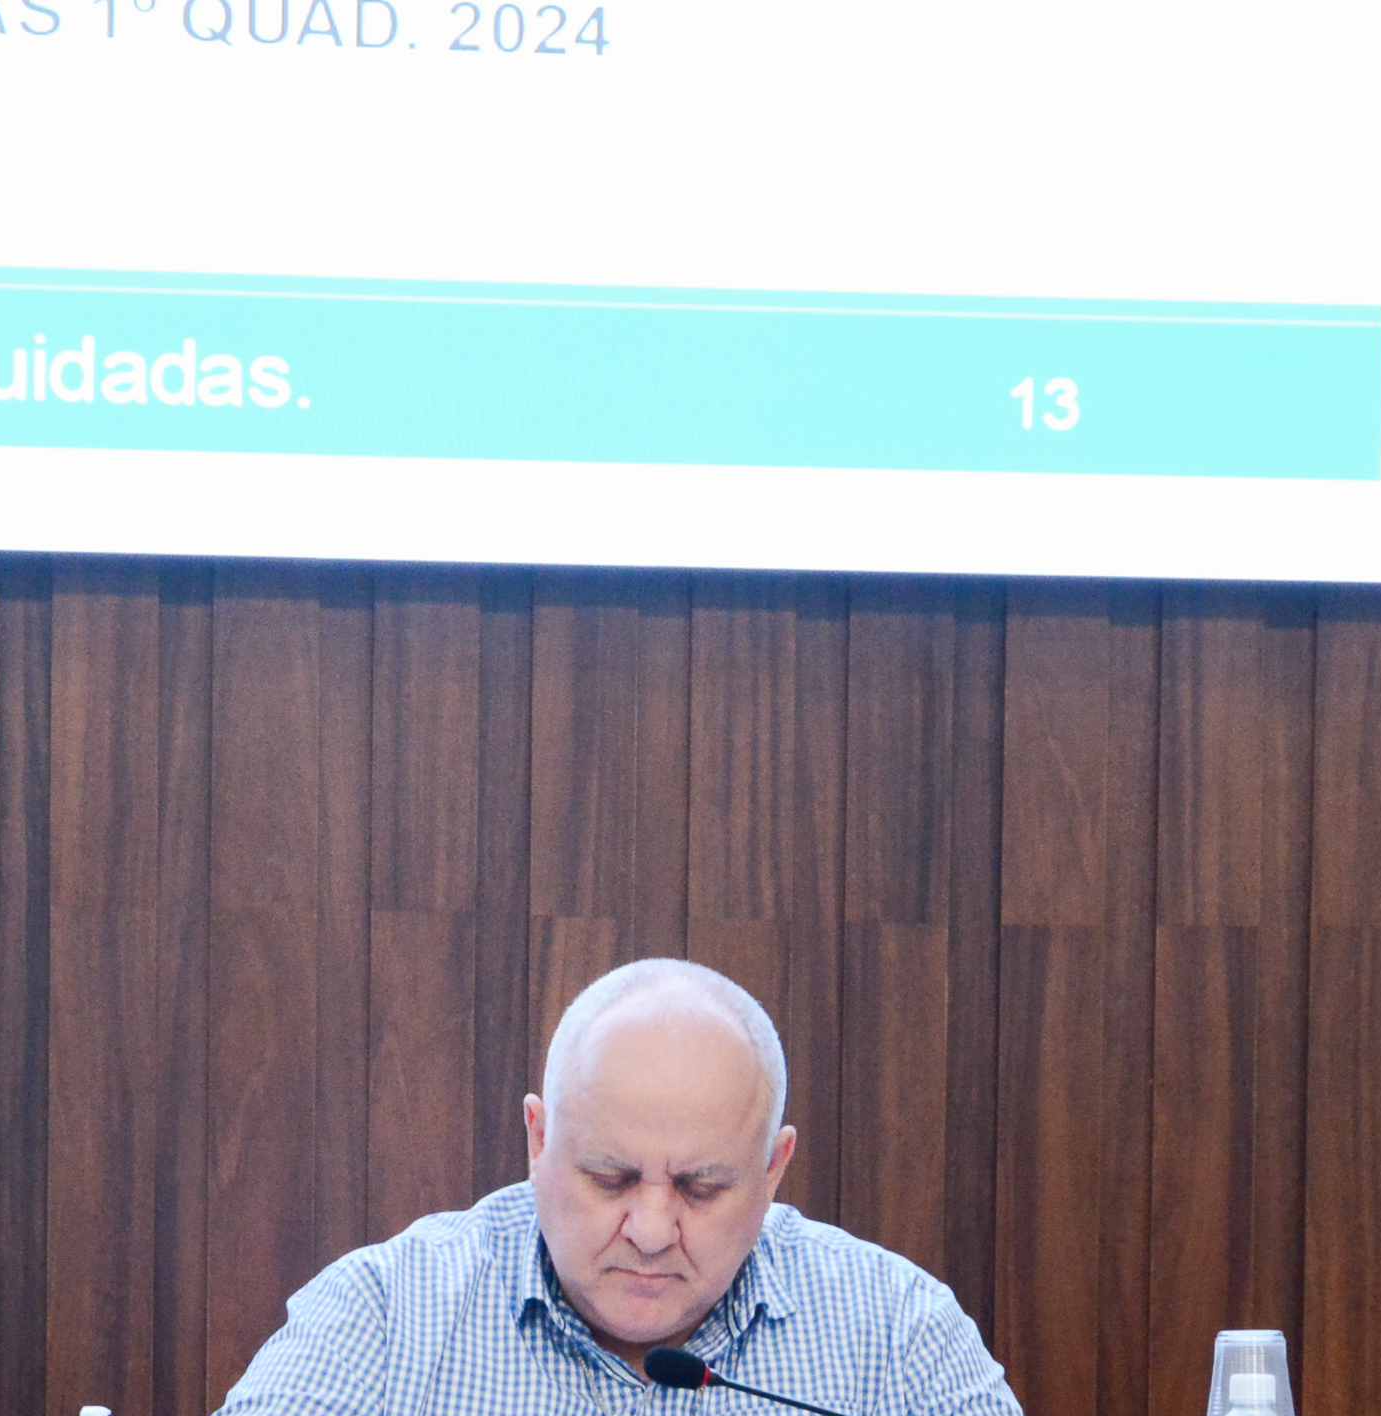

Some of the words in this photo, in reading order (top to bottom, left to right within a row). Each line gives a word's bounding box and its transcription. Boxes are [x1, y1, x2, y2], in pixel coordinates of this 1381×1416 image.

[183, 0, 415, 49] QUAD.
[449, 2, 610, 55] 2024
[1010, 377, 1080, 430] 13
